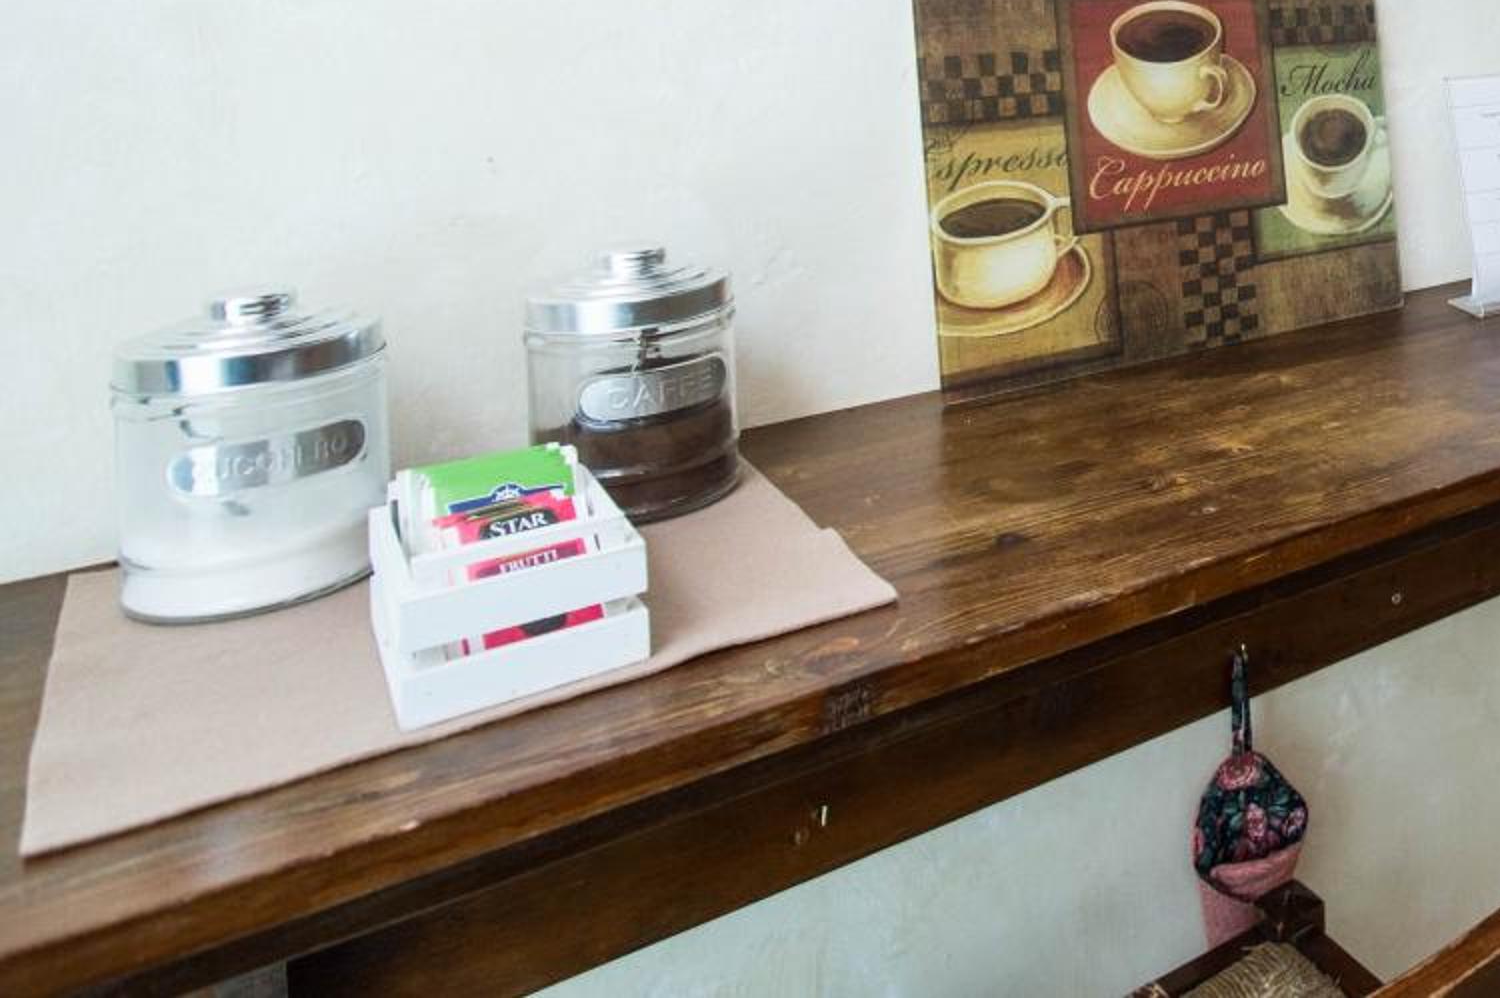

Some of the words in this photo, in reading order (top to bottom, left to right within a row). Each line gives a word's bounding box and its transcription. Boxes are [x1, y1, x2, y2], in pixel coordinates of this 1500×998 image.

[1279, 48, 1377, 97] Mocha
[929, 145, 1068, 191] spresso
[1089, 154, 1268, 212] Cappuccino
[489, 511, 548, 537] STAR
